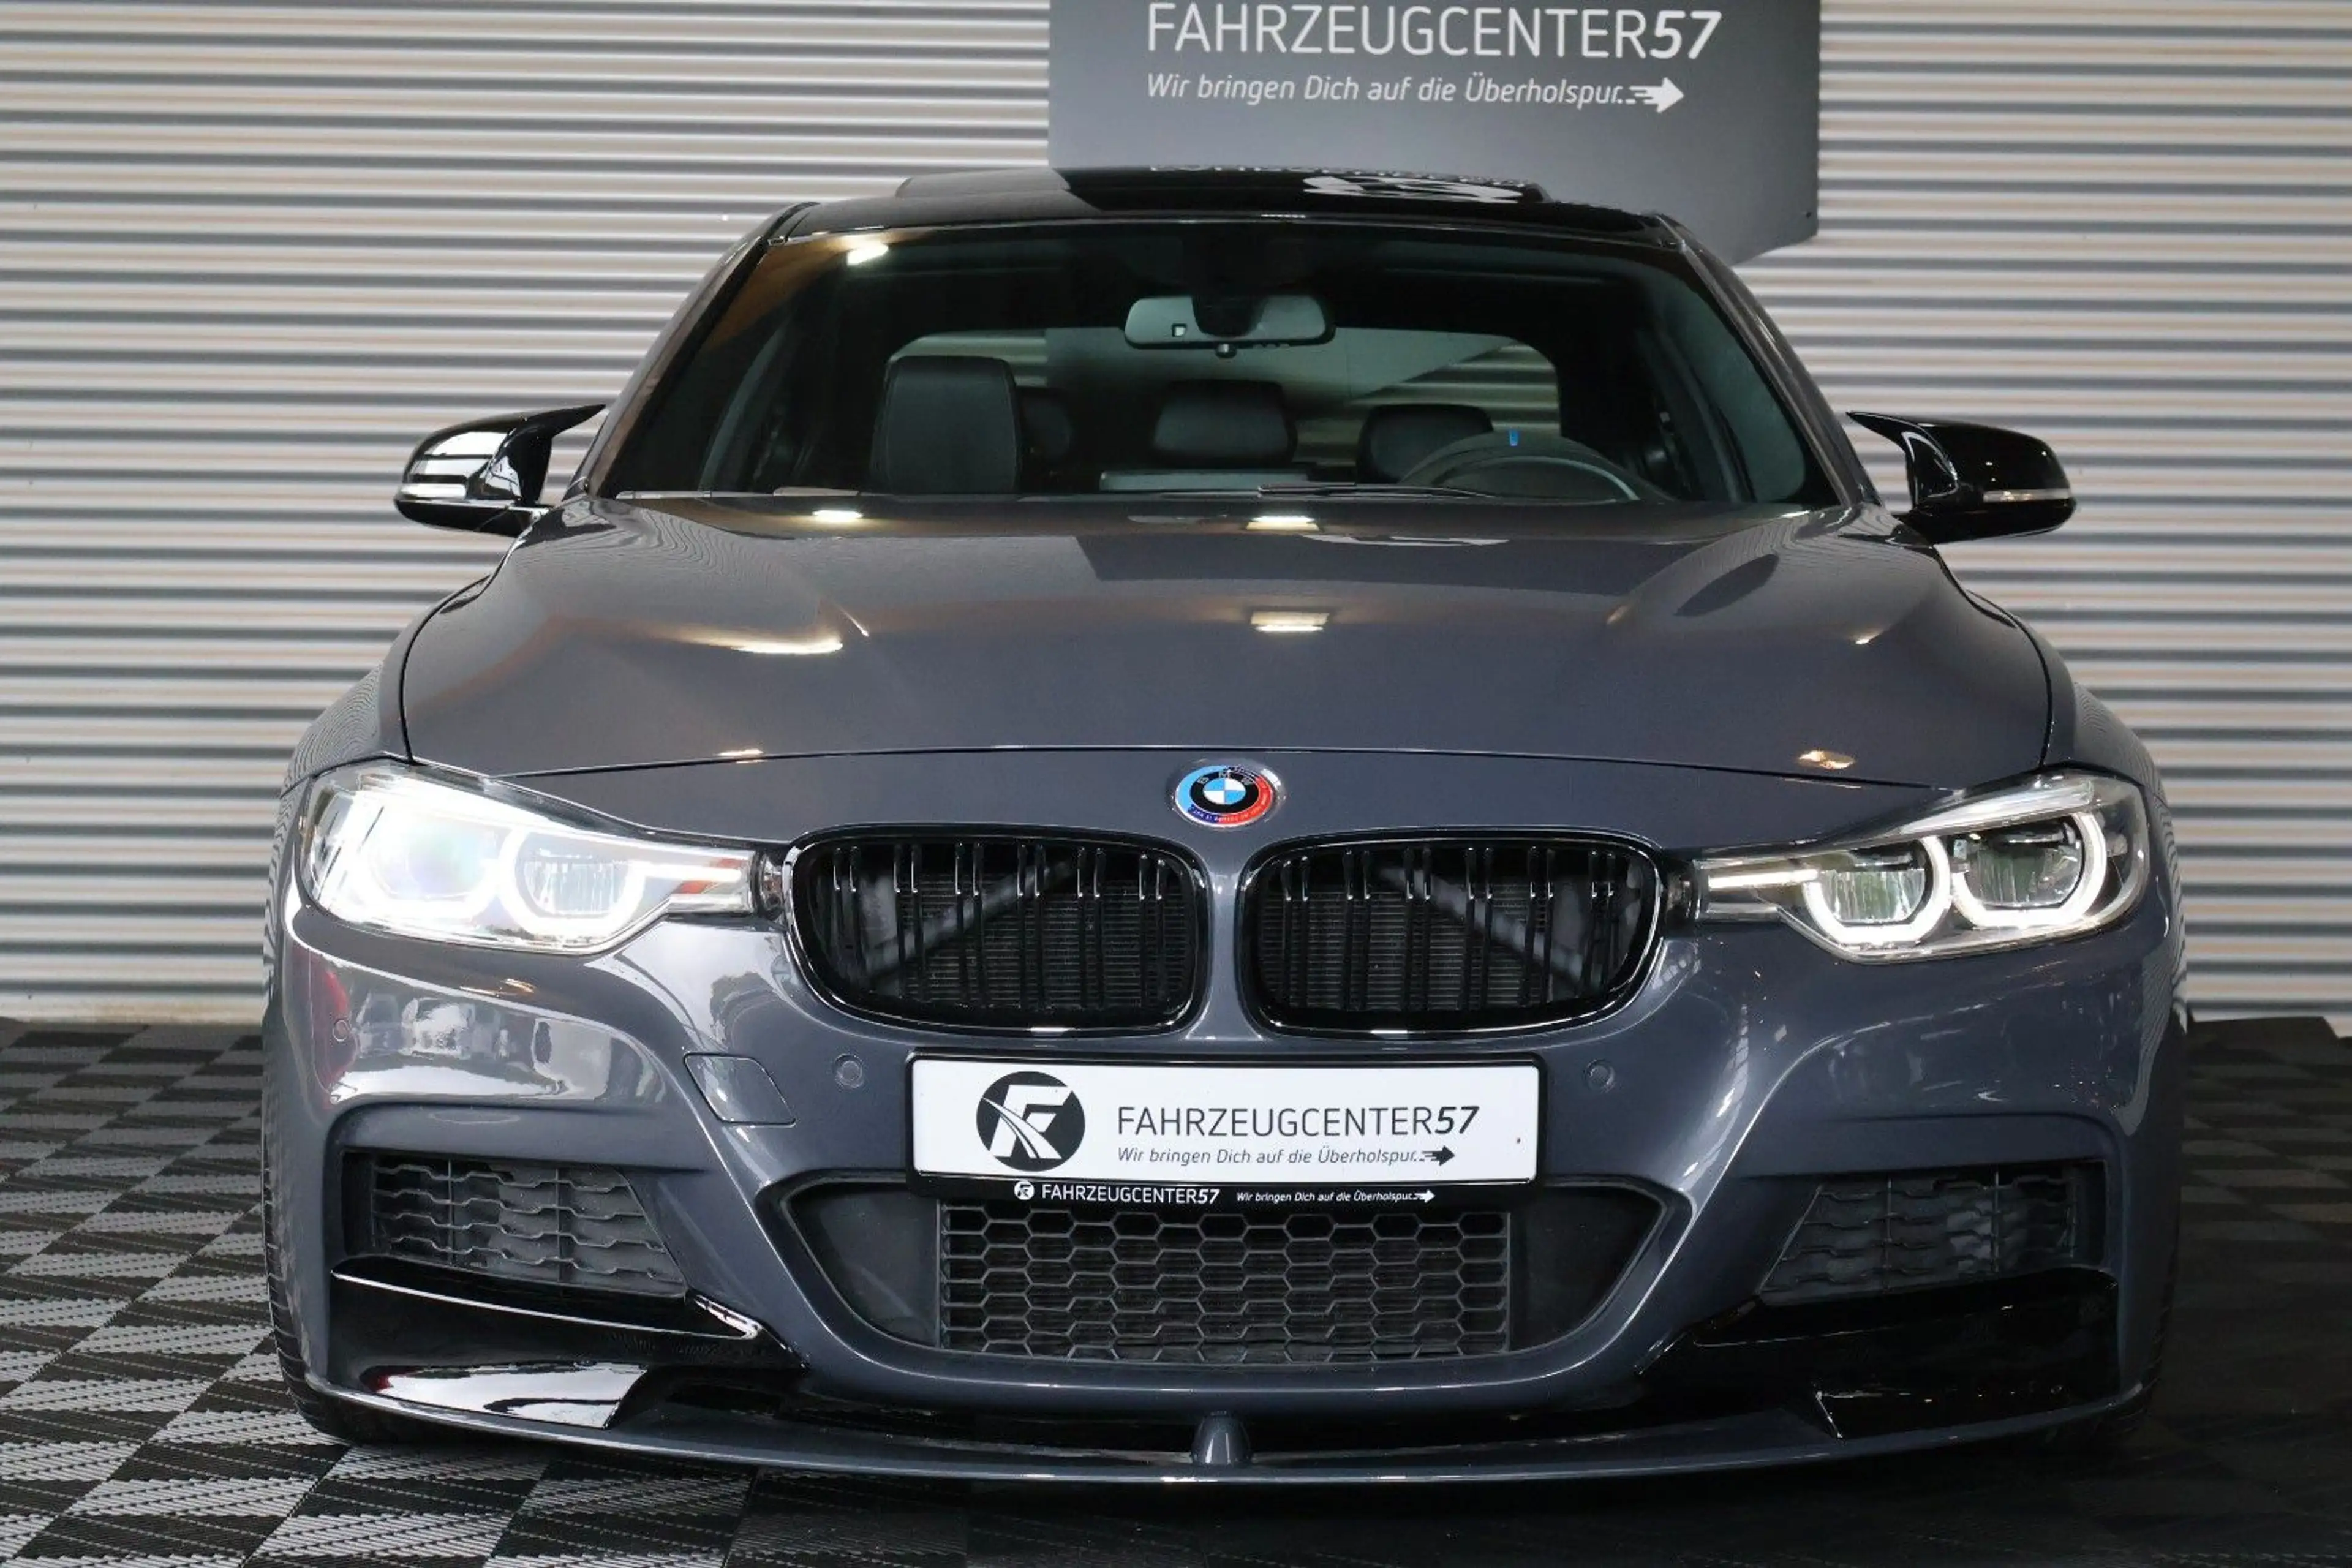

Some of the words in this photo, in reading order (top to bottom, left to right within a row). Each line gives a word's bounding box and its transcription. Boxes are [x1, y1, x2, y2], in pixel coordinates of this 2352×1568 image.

[1147, 2, 1722, 60] FAHRZEUGCENTER57
[1147, 73, 1189, 98] Wir
[1197, 74, 1295, 106] bringen
[1305, 75, 1359, 101] Dich
[1368, 76, 1412, 102] auf
[1419, 77, 1457, 102] die
[1118, 1105, 1480, 1137] FAHRZEUGCENTER57
[1118, 1147, 1144, 1163] Wir
[1149, 1147, 1211, 1167] bringen
[1216, 1148, 1251, 1164] Dich
[1256, 1148, 1284, 1164] auf
[1289, 1148, 1312, 1164] die
[1041, 1184, 1221, 1204] FAHRZEUGCENTER57
[1237, 1191, 1253, 1202] Wir
[1255, 1191, 1292, 1204] bringen
[1294, 1191, 1316, 1202] Dich
[1317, 1192, 1335, 1202] auf
[1336, 1192, 1351, 1202] die
